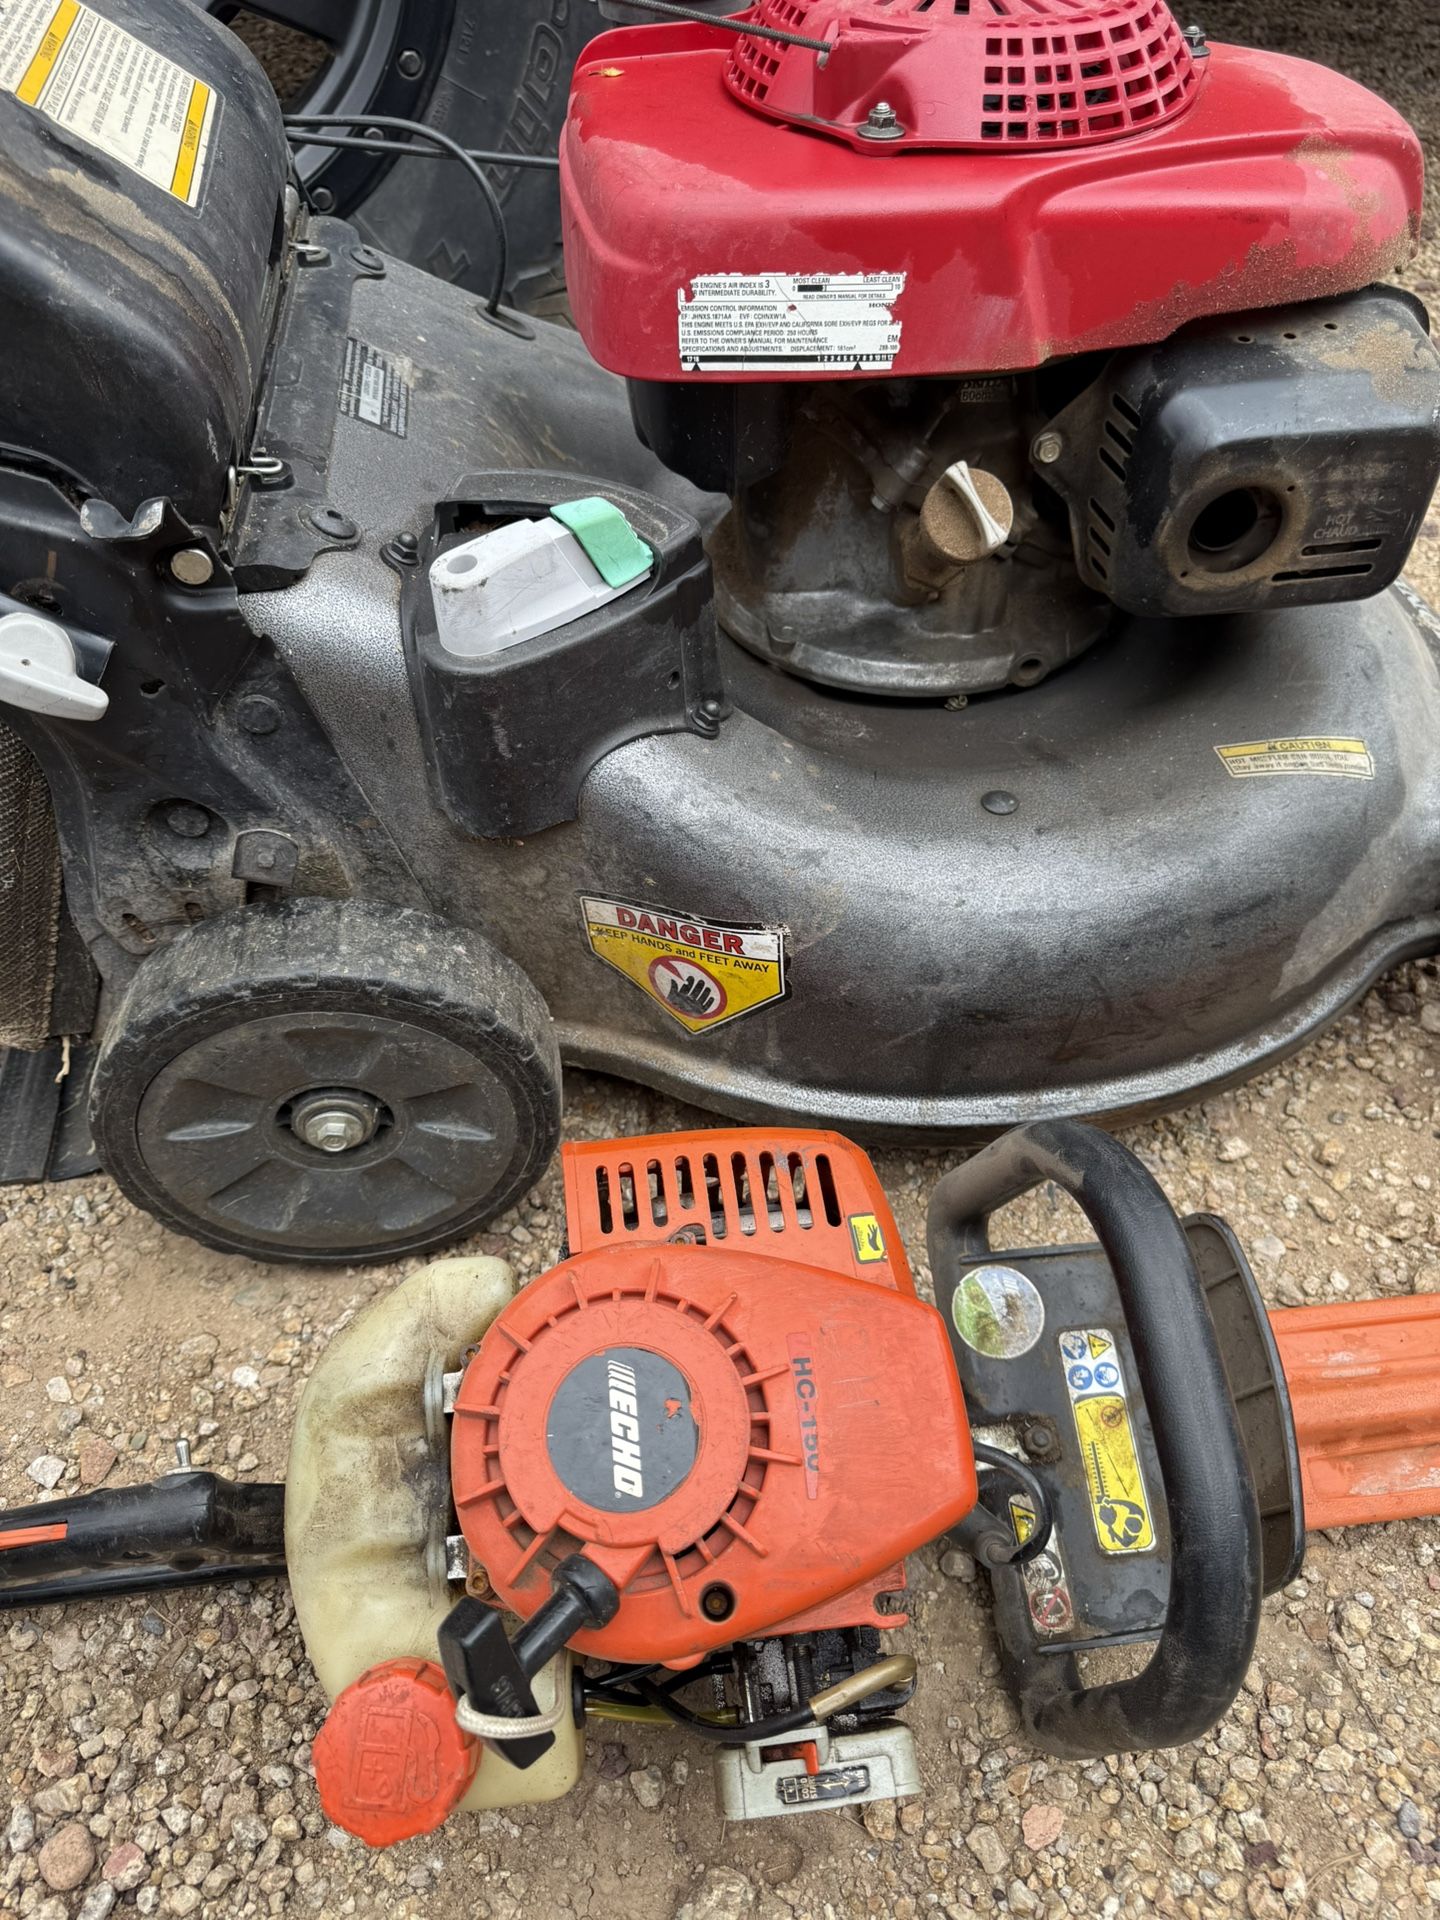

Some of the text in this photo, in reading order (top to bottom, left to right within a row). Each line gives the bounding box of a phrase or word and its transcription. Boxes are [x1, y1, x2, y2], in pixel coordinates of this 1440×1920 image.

[765, 280, 770, 288] 3
[1313, 526, 1358, 539] CHAUD
[1280, 742, 1331, 750] CAUTION
[616, 907, 746, 955] DANGER
[597, 926, 770, 973] KEEP HANDS and FEET AWAY
[609, 1389, 643, 1498] ECHO
[800, 1777, 809, 1799] COD
